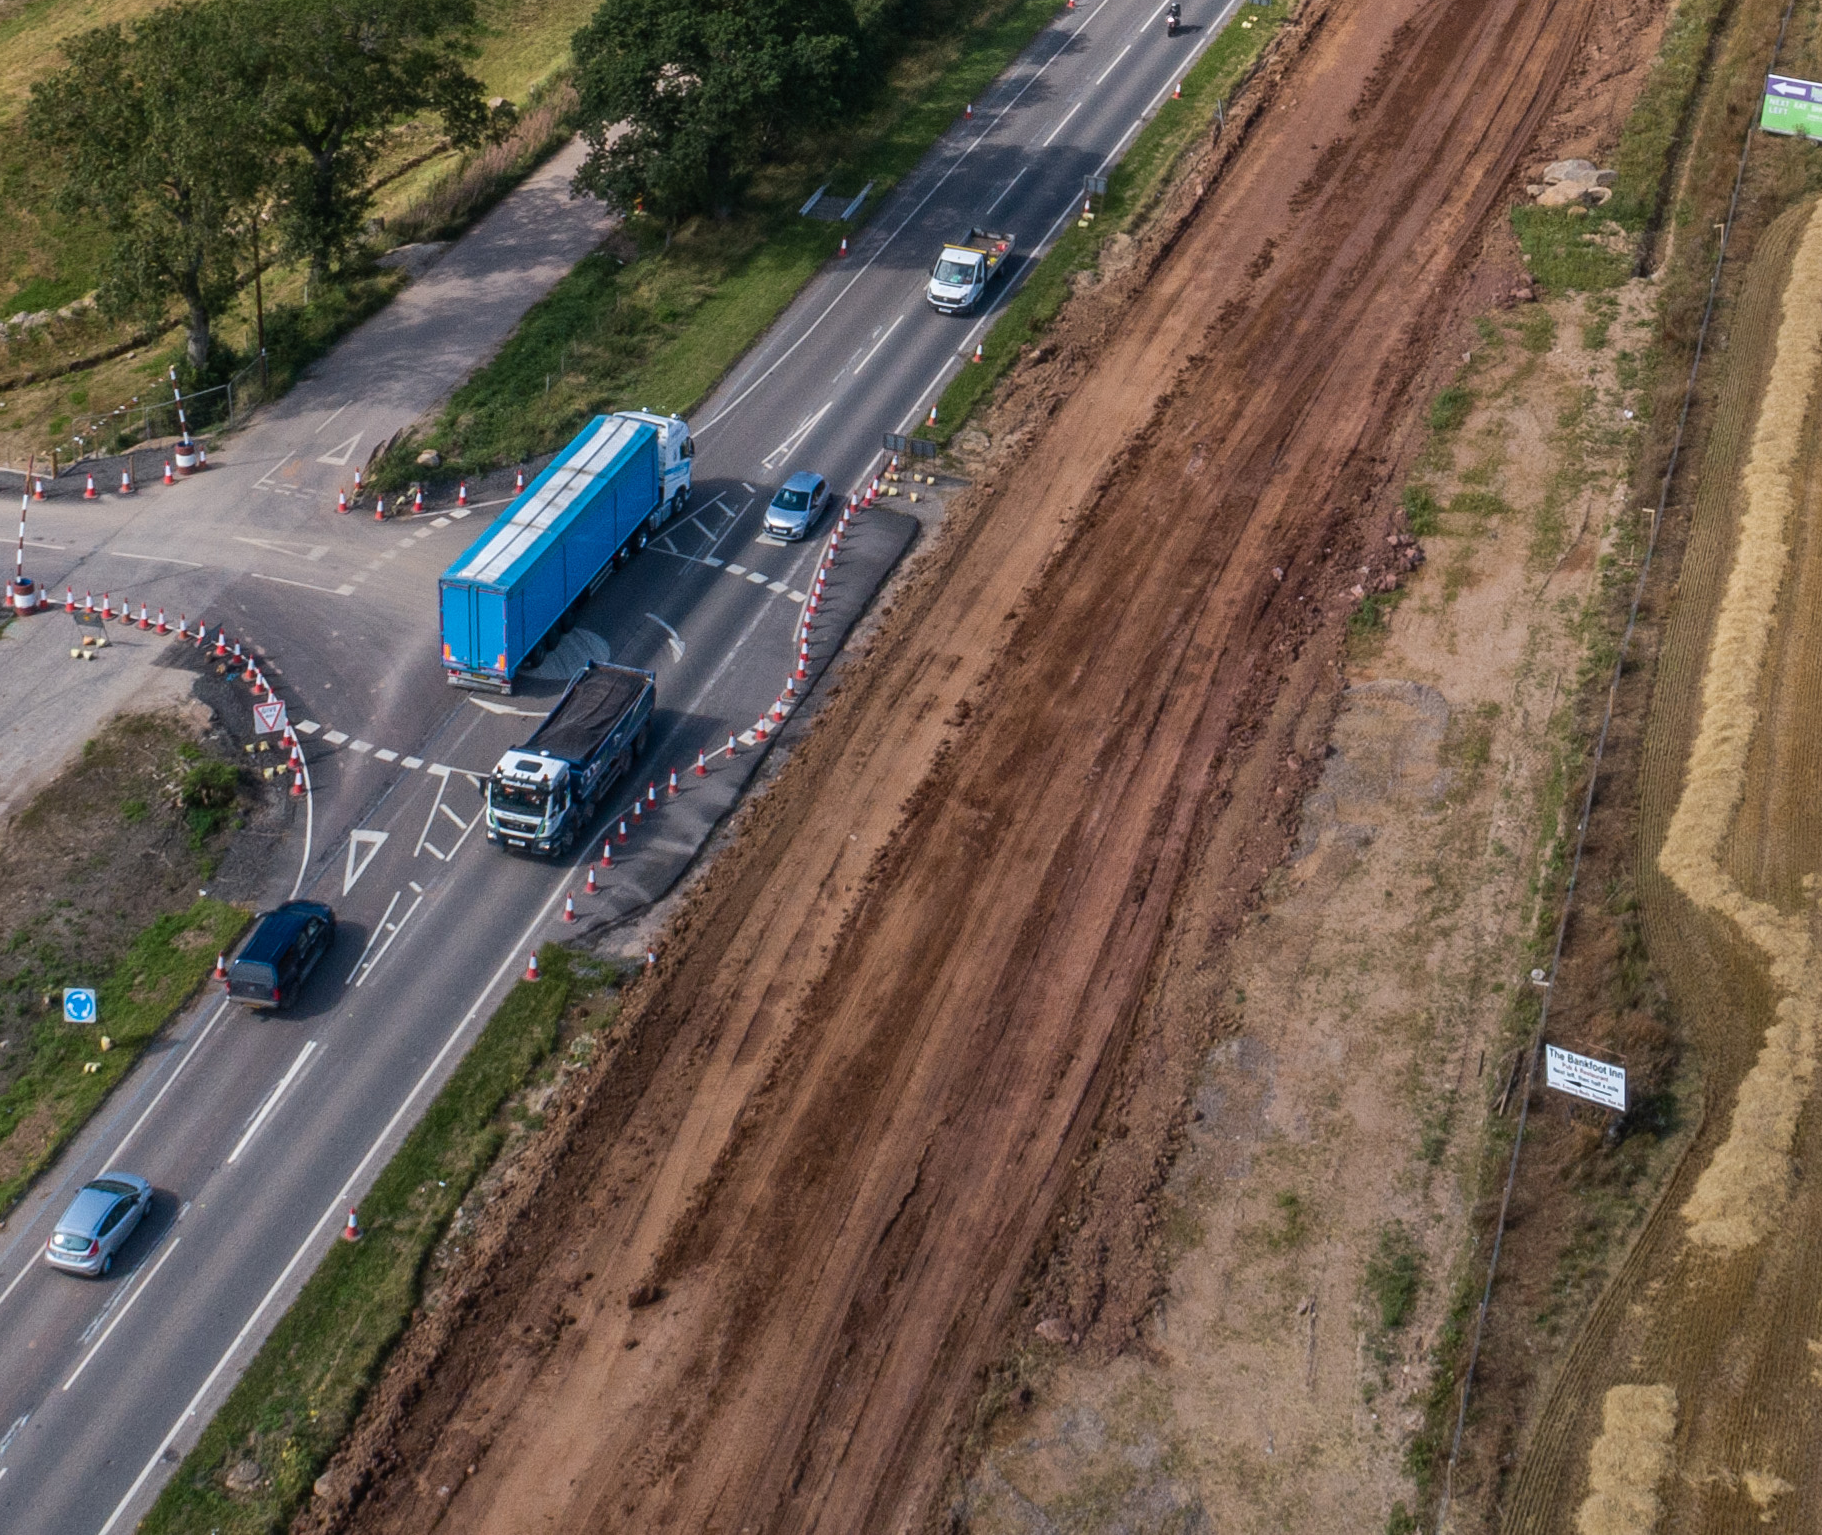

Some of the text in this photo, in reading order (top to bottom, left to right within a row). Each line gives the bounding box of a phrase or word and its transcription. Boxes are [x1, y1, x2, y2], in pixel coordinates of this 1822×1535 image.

[1769, 97, 1790, 107] NEXT
[1793, 101, 1807, 110] EAT
[1768, 106, 1788, 115] LEFT
[261, 706, 276, 714] GIVE
[1549, 1047, 1624, 1079] The Bankfoot Inn
[1561, 1062, 1573, 1070] Pub
[1579, 1068, 1609, 1082] Restaurant
[1553, 1067, 1565, 1075] Next
[1578, 1075, 1590, 1083] then
[1591, 1079, 1602, 1087] half
[1607, 1085, 1619, 1093] mile
